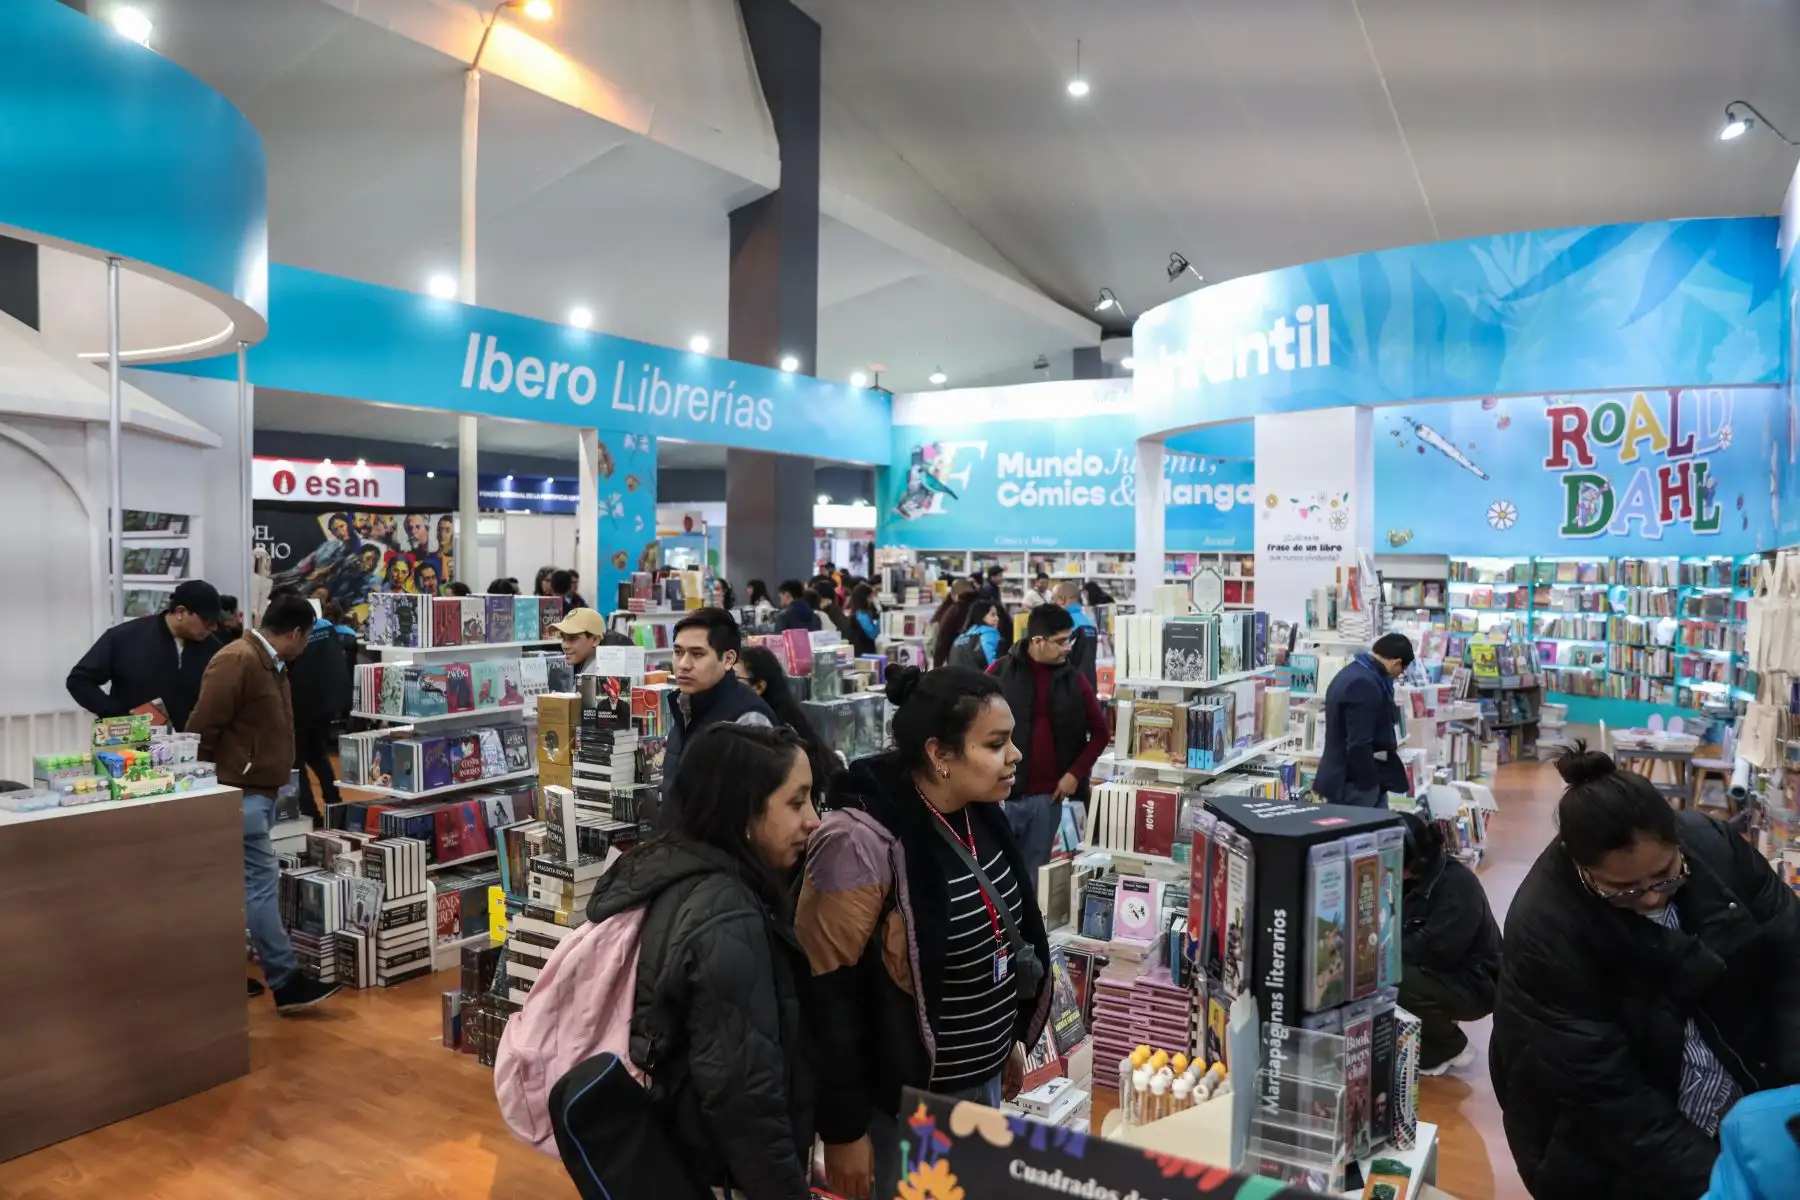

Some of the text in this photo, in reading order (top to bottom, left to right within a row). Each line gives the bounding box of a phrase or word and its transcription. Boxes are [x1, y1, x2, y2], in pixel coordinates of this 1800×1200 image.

[1142, 303, 1331, 390] fantil
[461, 333, 774, 431] Ibero Librerías
[1544, 388, 1734, 470] ROALD
[997, 448, 1103, 478] Mundo
[305, 475, 380, 498] esan
[997, 478, 1105, 507] Cómics
[1558, 459, 1722, 540] DAHL
[254, 525, 275, 541] EL
[1267, 543, 1342, 552] frase de un libro
[1141, 800, 1155, 830] novela
[1260, 908, 1289, 1115] Marcapáginas literarios
[1346, 1030, 1370, 1051] Book
[1345, 1048, 1370, 1067] lovers
[1348, 1061, 1368, 1080] club
[1008, 1158, 1120, 1200] Cuadrados
